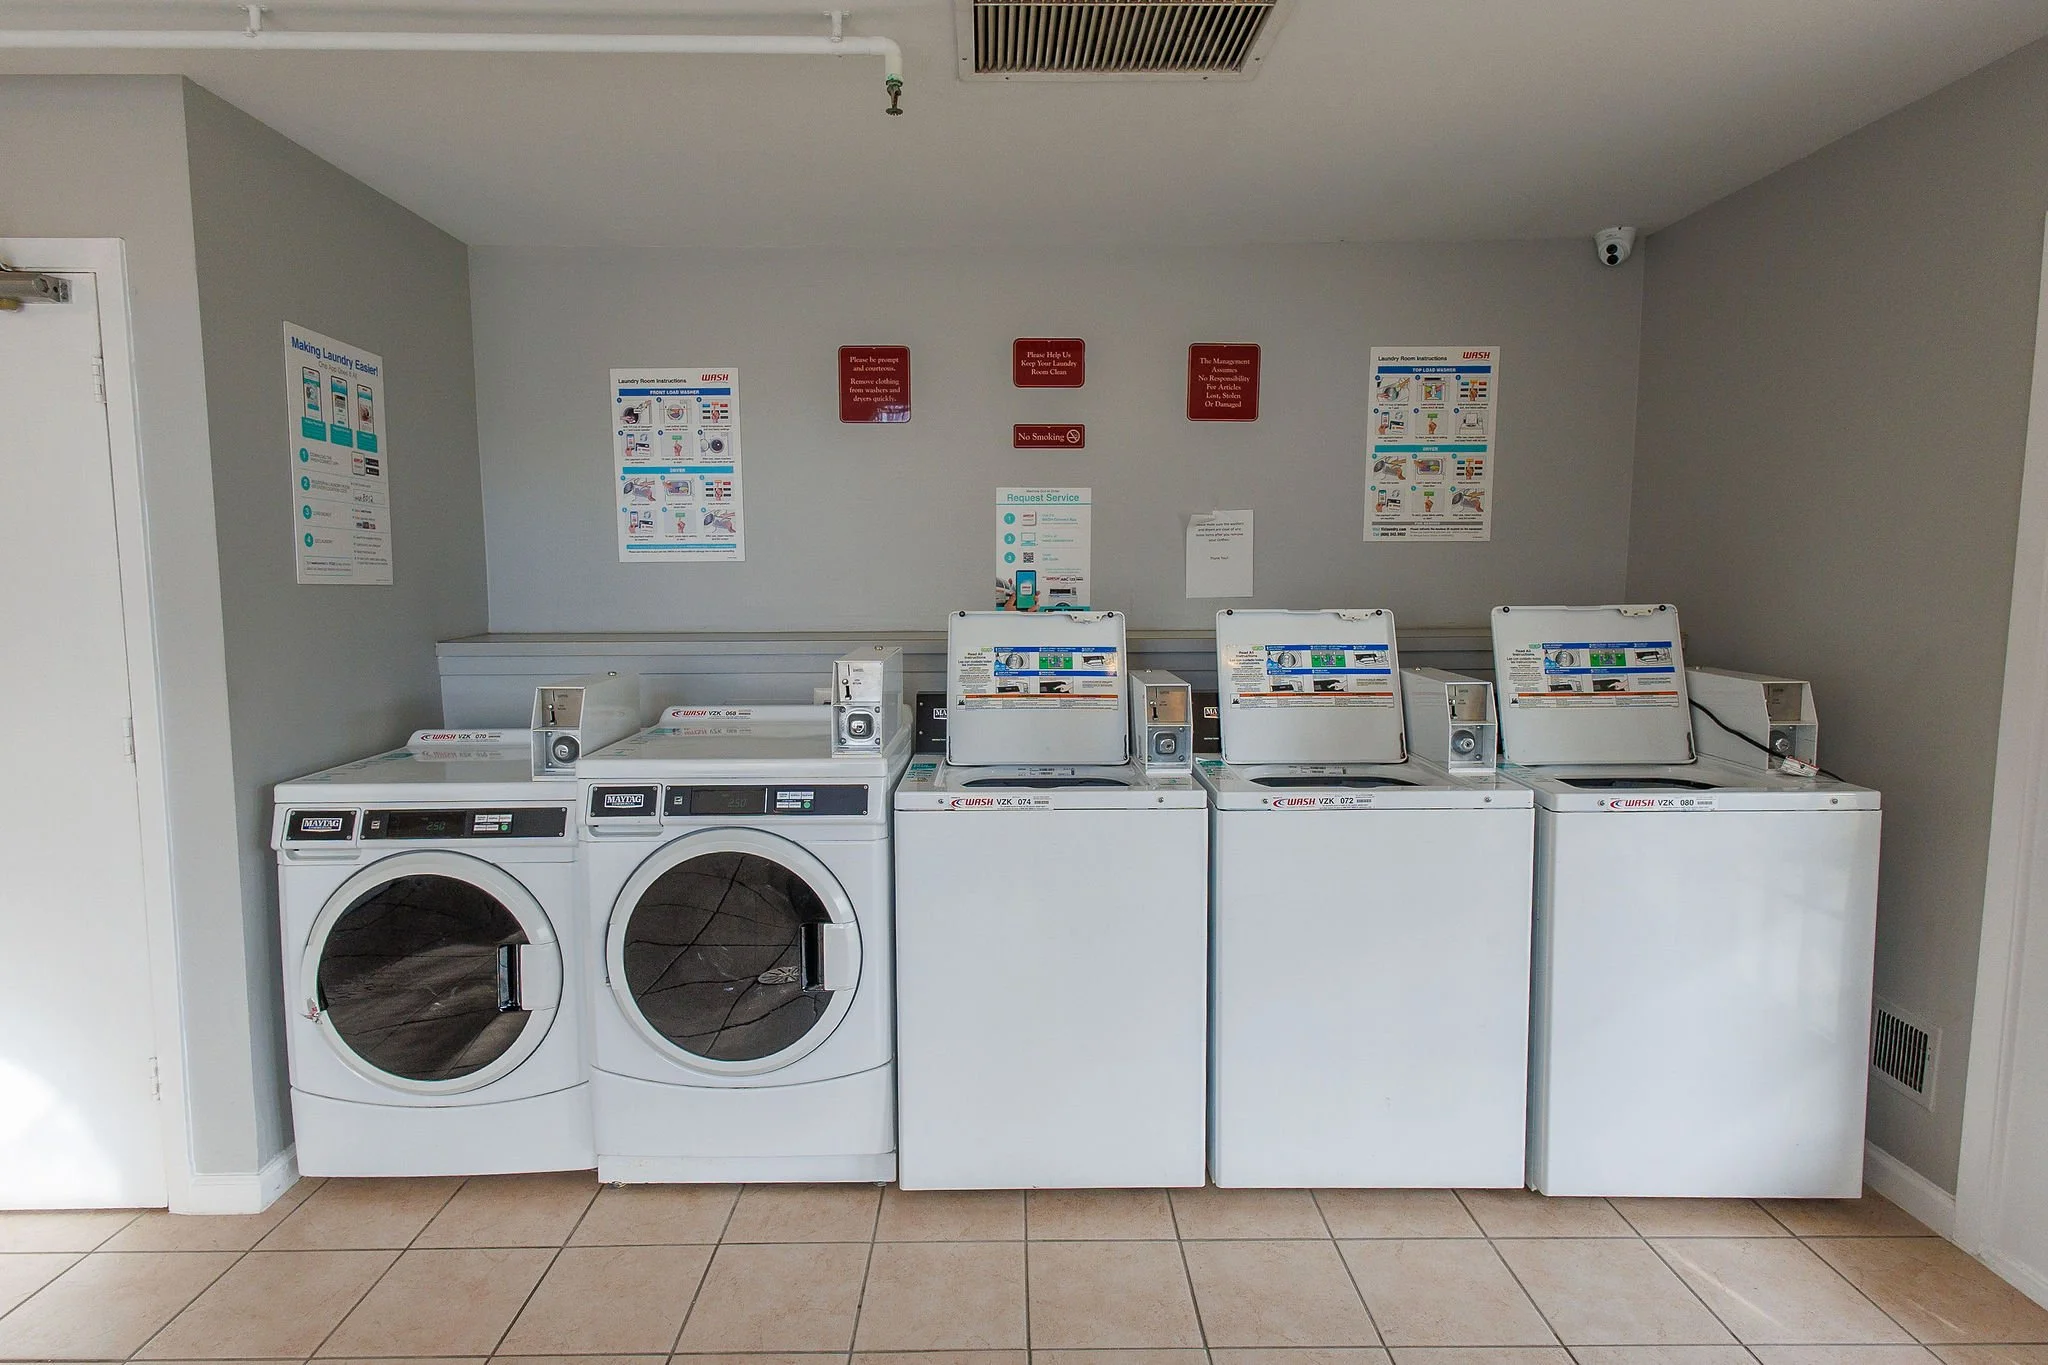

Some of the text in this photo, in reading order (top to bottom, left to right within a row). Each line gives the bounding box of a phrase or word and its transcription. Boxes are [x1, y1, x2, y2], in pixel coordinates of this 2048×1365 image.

[291, 336, 378, 376] Making Laundry Easier!
[1018, 432, 1064, 442] No Smoking
[1007, 493, 1079, 503] Request Service
[426, 821, 446, 832] 250
